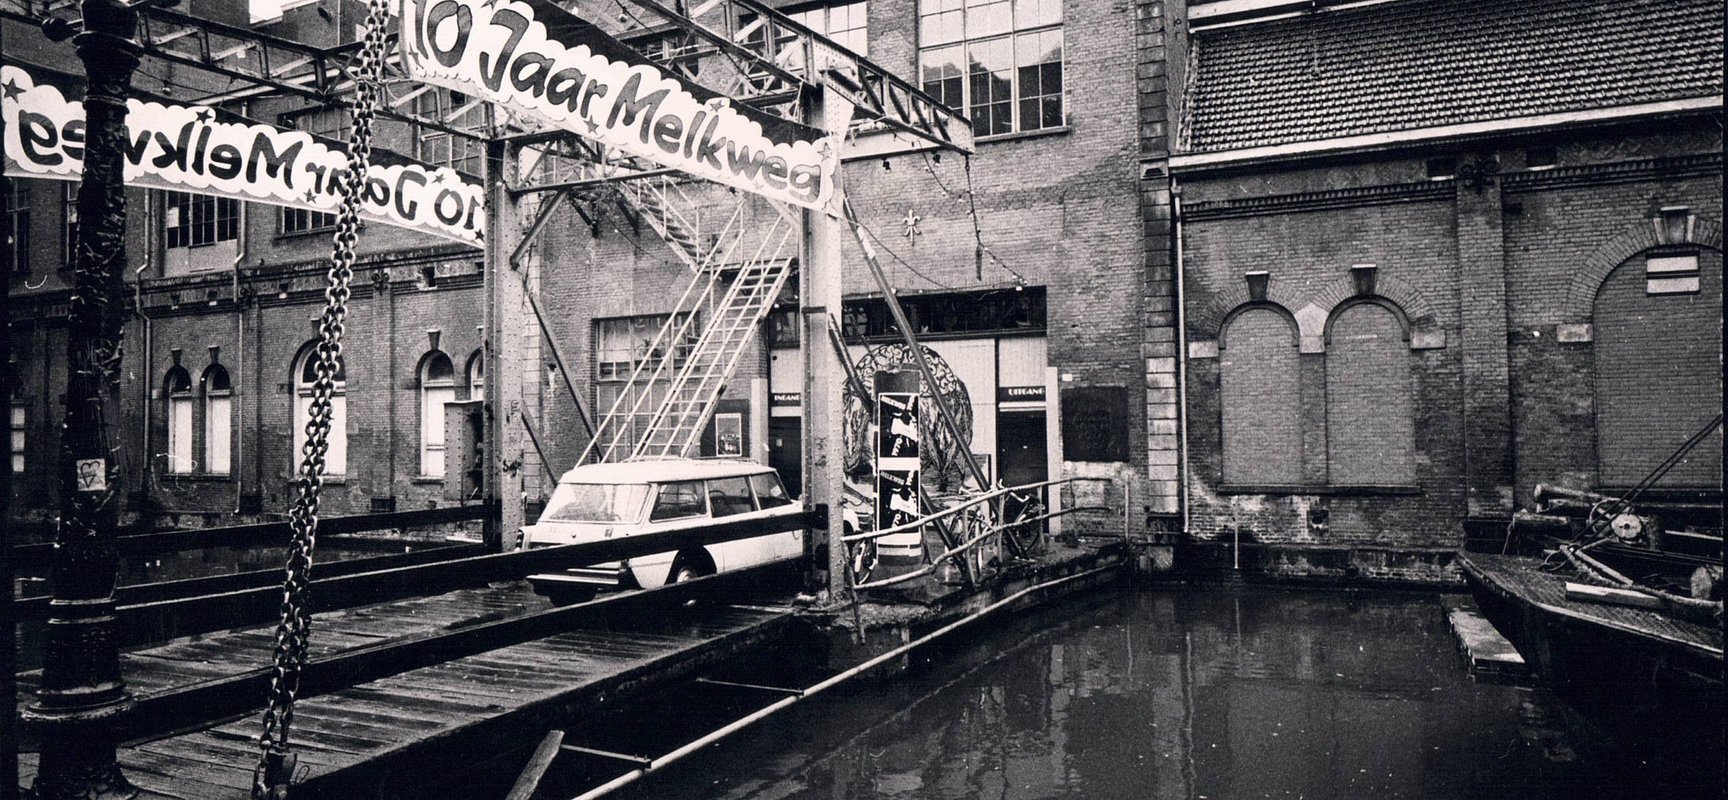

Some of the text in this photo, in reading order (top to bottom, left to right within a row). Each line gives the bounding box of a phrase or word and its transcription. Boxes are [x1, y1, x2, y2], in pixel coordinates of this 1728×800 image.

[411, 0, 822, 203] 10 Jaar Melkweg
[1008, 387, 1045, 396] UITGANG
